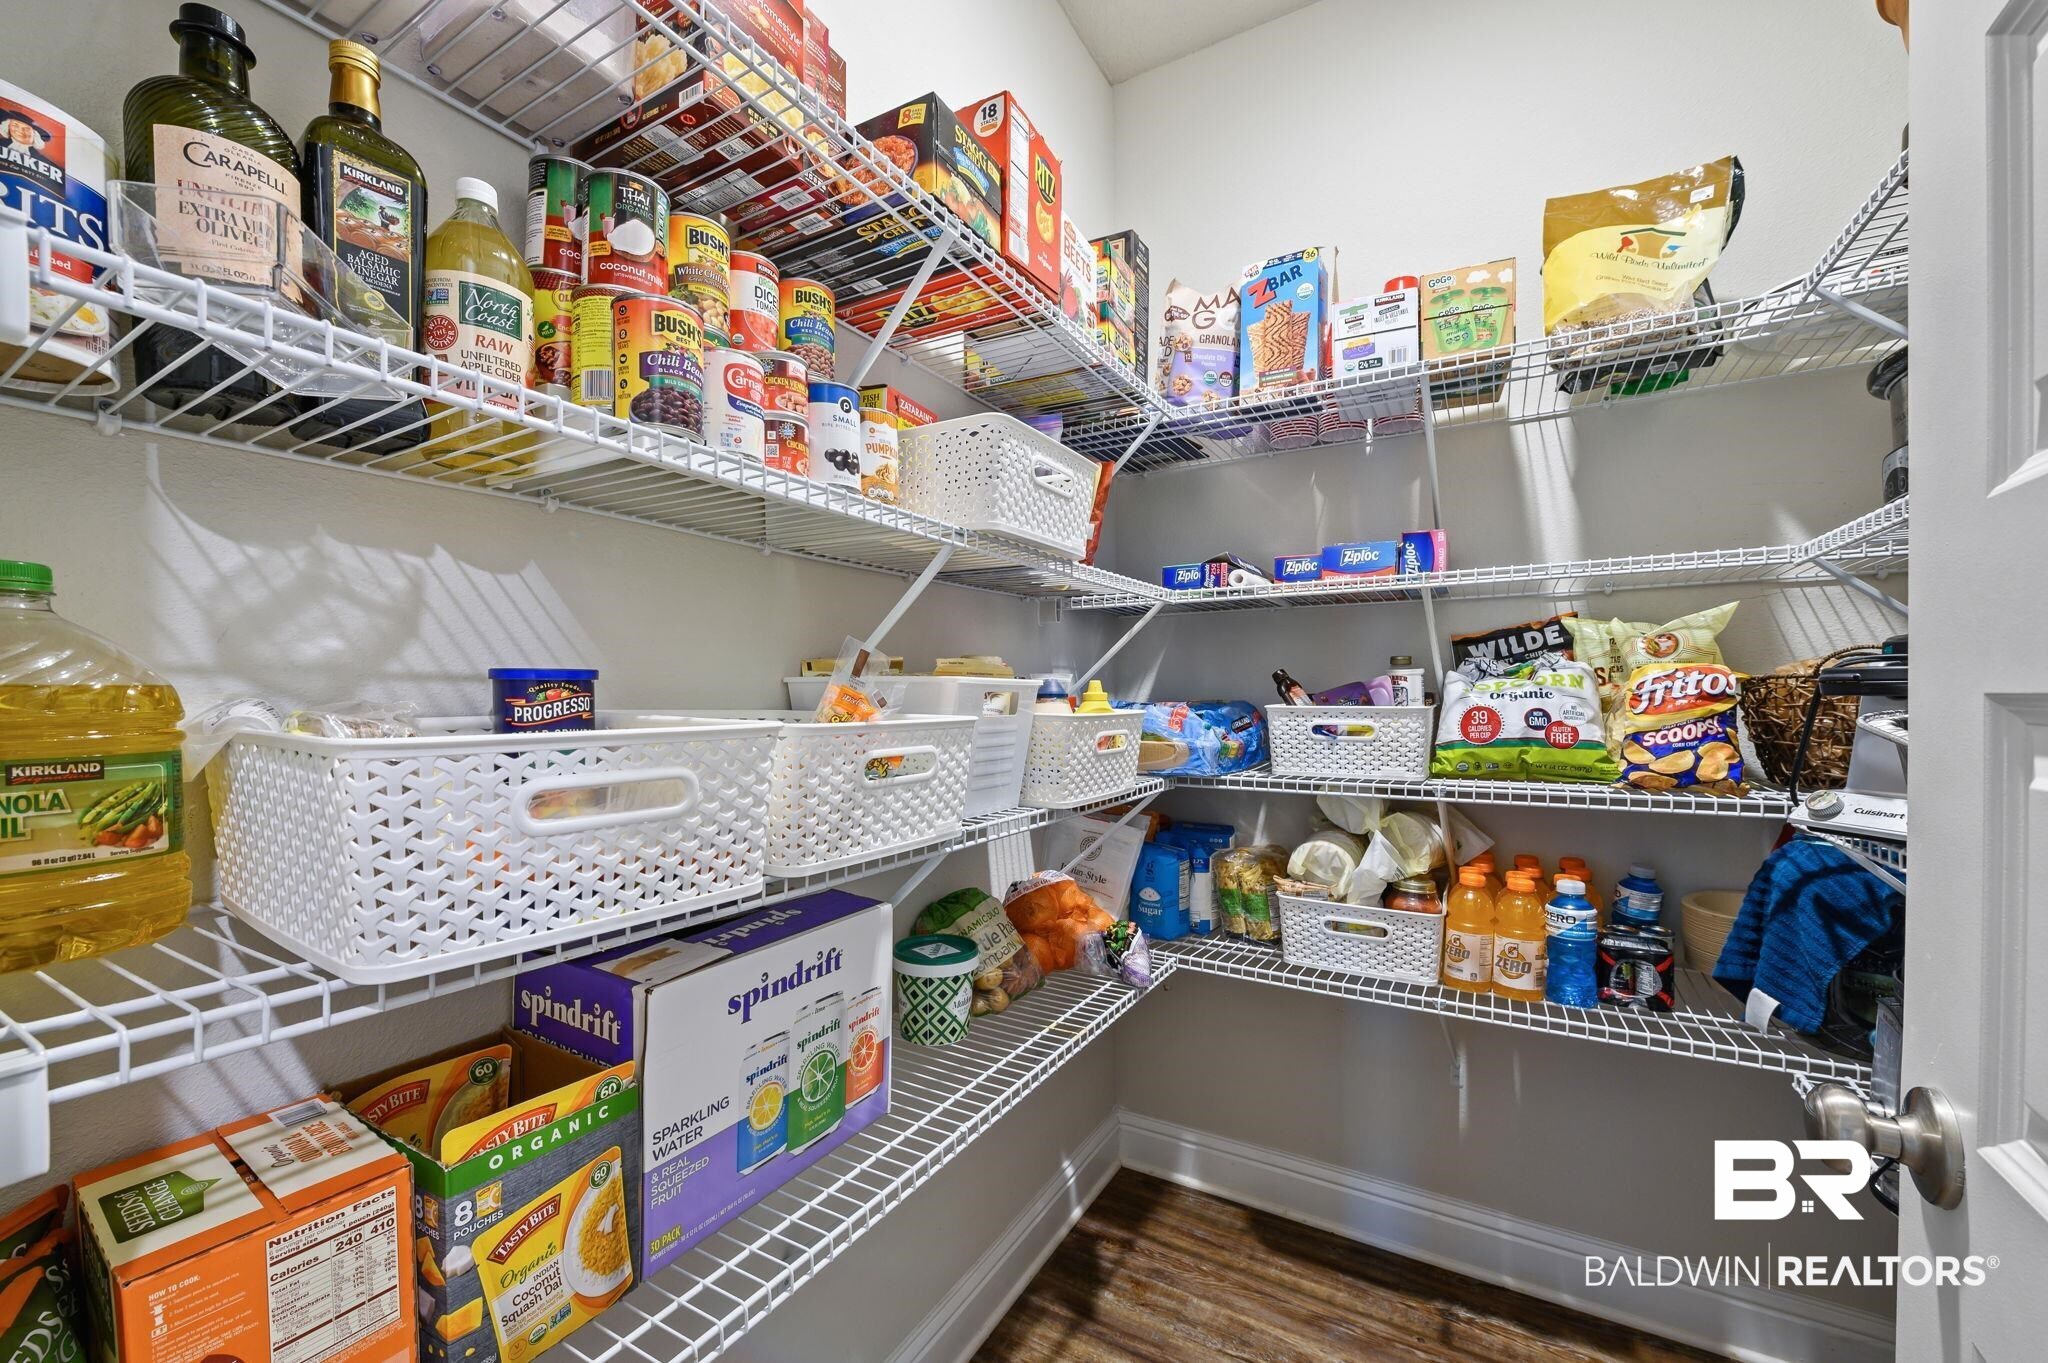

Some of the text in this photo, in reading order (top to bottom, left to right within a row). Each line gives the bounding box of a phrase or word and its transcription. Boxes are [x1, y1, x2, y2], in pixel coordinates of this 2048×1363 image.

[902, 111, 912, 124] 8
[980, 103, 997, 121] 18
[980, 117, 998, 126] STACKS
[183, 141, 285, 195] CARAPELLI
[343, 165, 403, 195] KIRKLAND
[1035, 152, 1056, 201] RITZ
[618, 186, 650, 206] THAI
[623, 199, 649, 211] KITCHEN
[179, 200, 238, 227] EXTRA
[615, 202, 654, 221] ORGANIC
[196, 218, 253, 245] OLIVE
[360, 250, 389, 266] AGED
[704, 247, 724, 260] BEST
[1064, 234, 1092, 283] BEETS
[1305, 249, 1316, 259] 36
[1591, 252, 1709, 270] Wild Birds Unlimited
[347, 254, 401, 279] BALSAMIC
[350, 263, 399, 287] VINEGAR
[600, 262, 664, 289] coconut milk
[677, 266, 722, 283] White Chili
[466, 287, 519, 319] North
[755, 285, 778, 308] DICE
[795, 289, 832, 315] BUSH'S
[429, 318, 448, 330] WITH
[465, 305, 515, 330] Coast
[790, 318, 814, 329] Chili
[429, 330, 455, 347] MOTHER
[433, 328, 447, 336] THE
[654, 313, 702, 348] BUSH'S
[676, 336, 691, 346] BEST
[1199, 334, 1236, 347] GRANOLA
[475, 334, 514, 355] RAW
[460, 349, 521, 373] UNFILTERED
[647, 353, 680, 367] Chili
[659, 368, 684, 376] BLACK
[460, 361, 521, 384] APPLE CIDER
[764, 376, 789, 386] CHICKEN
[862, 392, 880, 404] FISH
[832, 414, 857, 428] SMALL
[900, 399, 933, 423] ZATARAIN'S
[786, 439, 806, 450] CHICKEN
[1286, 561, 1318, 575] Ziploc
[1343, 550, 1379, 565] Ziploc
[1404, 542, 1420, 577] Ziploc
[1177, 571, 1200, 583] Ziplo
[1468, 625, 1564, 659] WILDE
[528, 682, 581, 693] Quality Foods
[1489, 688, 1555, 702] organic
[1631, 668, 1737, 715] Fritos
[514, 697, 590, 722] PROGRESSO
[1471, 710, 1488, 725] 39
[1529, 716, 1548, 726] GMO
[1468, 725, 1492, 733] CALORIES
[1551, 733, 1574, 744] FREE
[1642, 716, 1723, 747] SCOOPS!
[12, 763, 101, 778] KIRKLAND
[0, 791, 65, 815] NOLA
[1853, 806, 1905, 820] Cuisinart
[1137, 905, 1163, 917] Sugar
[704, 909, 802, 946] spindri
[1495, 955, 1532, 974] ZERO
[727, 946, 844, 1025] spindrift
[521, 986, 622, 1045] spindrift
[848, 1006, 880, 1033] spindrift
[797, 1018, 841, 1052] spindrift
[475, 1064, 492, 1077] 60
[746, 1054, 788, 1085] spindrift
[389, 1087, 420, 1109] BITE
[601, 1084, 616, 1098] 60
[513, 1112, 549, 1139] BITE
[652, 1096, 730, 1146] SPARKLING
[489, 1105, 609, 1169] ORGANIC
[652, 1126, 703, 1162] WATER
[594, 1168, 607, 1181] 60
[651, 1156, 690, 1184] & REAL
[651, 1156, 710, 1197] SQUEEZED
[144, 1178, 184, 1221] CHANGE
[415, 1194, 423, 1219] 8
[651, 1182, 683, 1209] FRUIT
[117, 1196, 156, 1234] SEEDS
[268, 1190, 395, 1249] Nutrition Facts
[348, 1213, 371, 1228] pouch
[372, 1202, 395, 1216] (240g)
[454, 1200, 474, 1227] 8
[454, 1209, 504, 1241] POUCHES
[275, 1219, 345, 1254] servings per container
[496, 1202, 557, 1259] TASTY BITE
[650, 1225, 682, 1254] 30 PACK
[269, 1237, 318, 1262] Serving size
[270, 1217, 395, 1282] Calories 240 410
[500, 1244, 557, 1289] Organic
[533, 1259, 559, 1282] INDIAN
[148, 1284, 177, 1301] HOW TO
[271, 1285, 289, 1296] Total
[512, 1266, 560, 1307] Coconut
[271, 1292, 310, 1313] Cholesterol
[272, 1293, 331, 1324] Total Carbohydrate
[272, 1305, 297, 1319] Sodium
[501, 1293, 542, 1328] Squash
[544, 1278, 562, 1297] Dal
[273, 1332, 298, 1346] Protein
